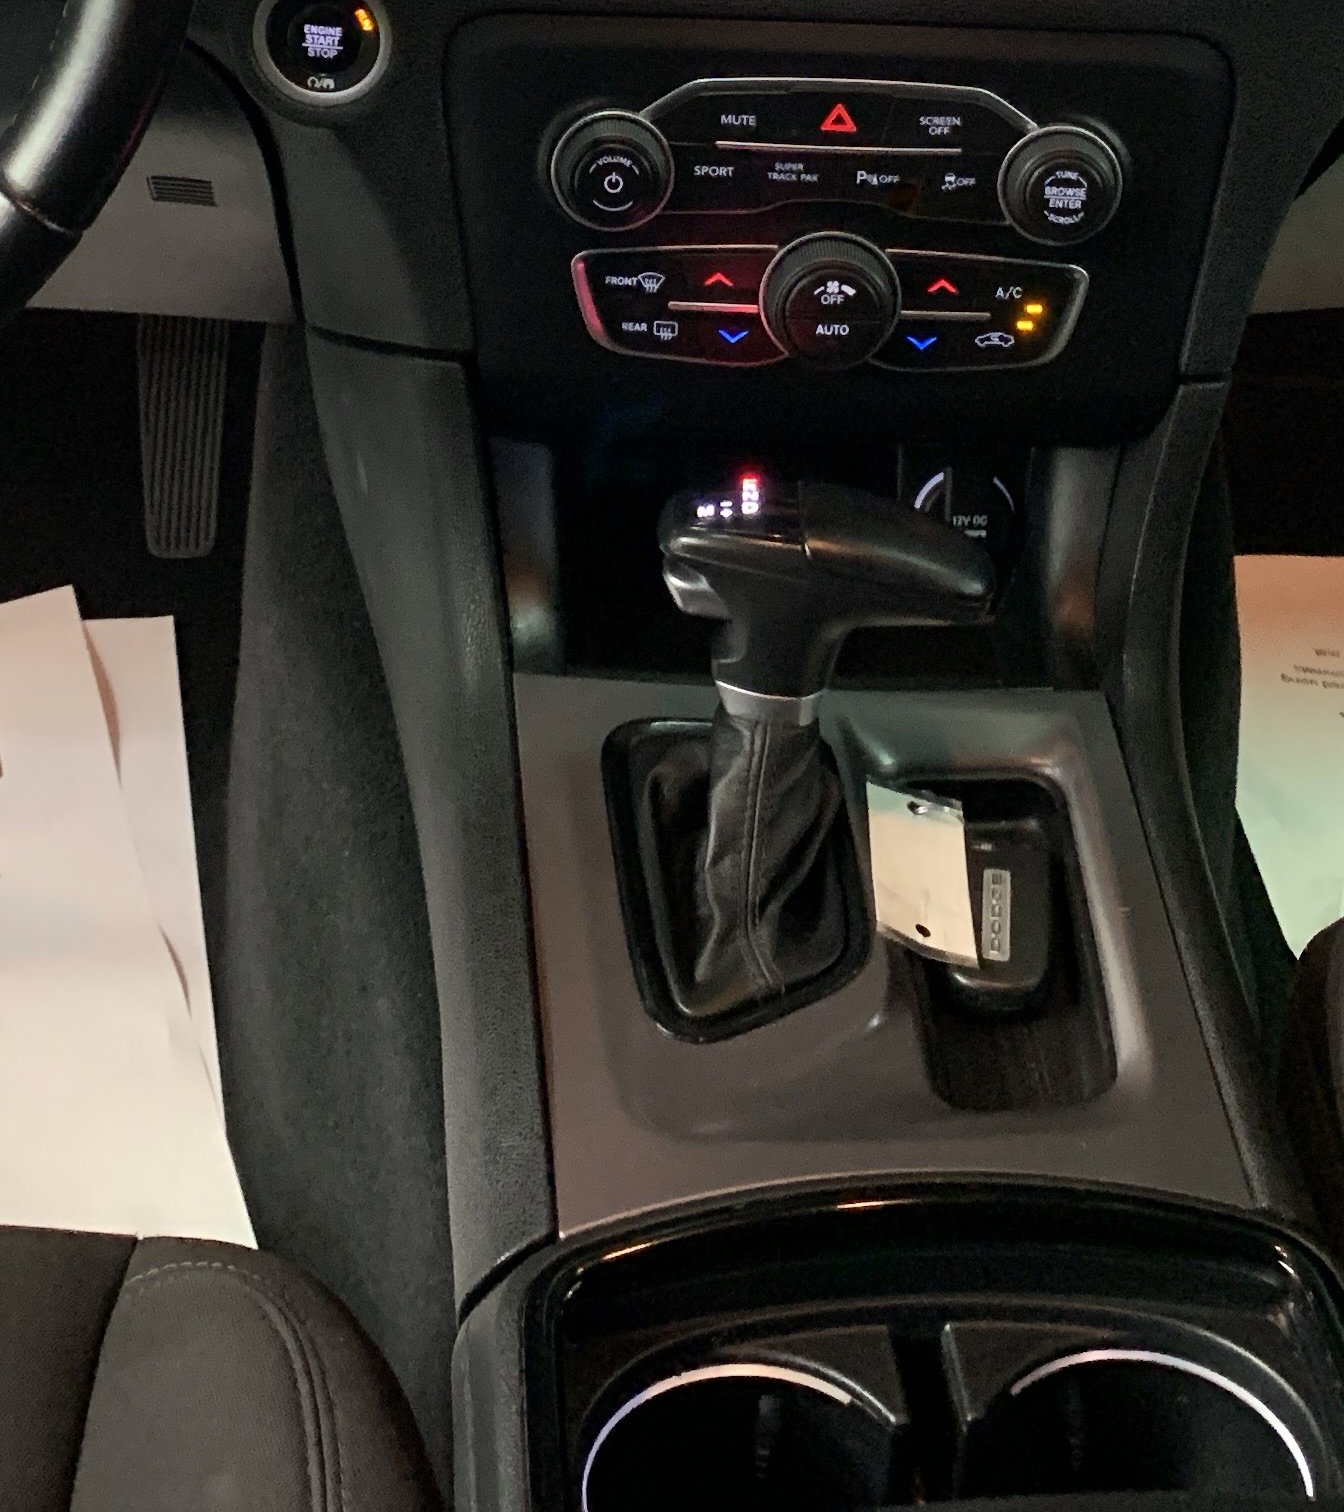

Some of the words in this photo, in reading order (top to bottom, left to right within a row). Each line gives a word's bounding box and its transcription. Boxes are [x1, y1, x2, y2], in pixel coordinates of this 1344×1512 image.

[303, 24, 343, 37] ENGINE
[305, 34, 340, 46] START
[307, 48, 338, 59] STOP
[720, 114, 756, 127] MUTE
[919, 116, 961, 127] SCREEN
[928, 126, 950, 136] OFF
[597, 155, 633, 168] VOLUME
[694, 165, 734, 177] SPORT
[879, 174, 901, 184] OFF
[956, 176, 976, 187] OFF
[1044, 186, 1087, 197] BROWSE
[1048, 198, 1082, 209] ENTER
[605, 275, 638, 286] FRONT
[995, 287, 1023, 300] A/C
[820, 294, 846, 305] OFF
[622, 322, 648, 333] REAR
[815, 324, 849, 336] AUTO
